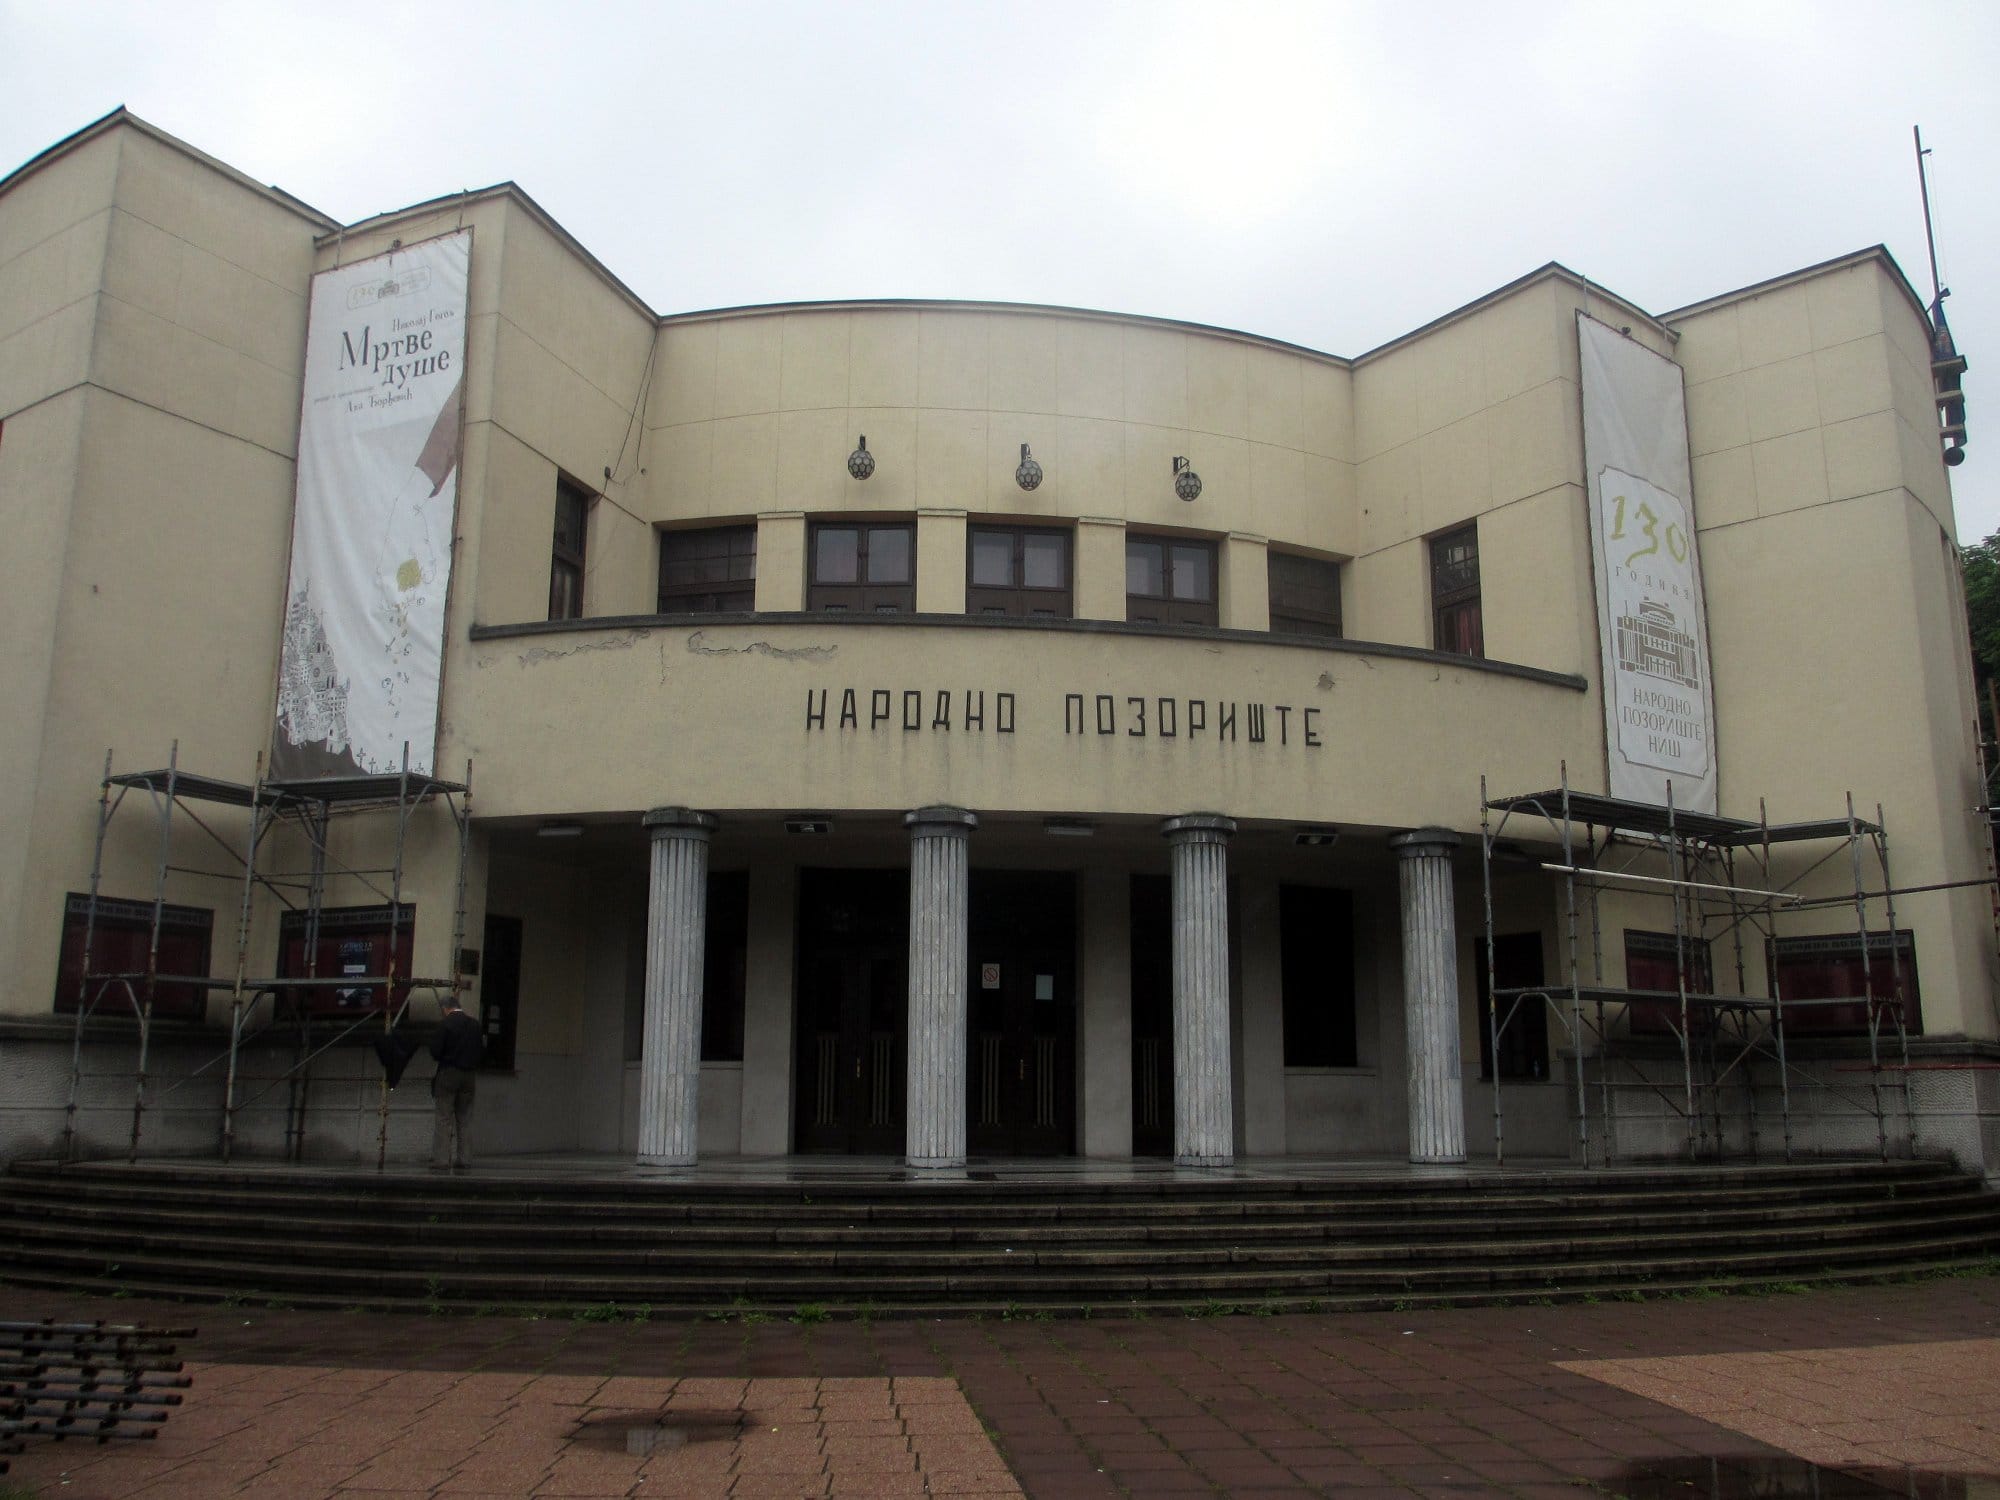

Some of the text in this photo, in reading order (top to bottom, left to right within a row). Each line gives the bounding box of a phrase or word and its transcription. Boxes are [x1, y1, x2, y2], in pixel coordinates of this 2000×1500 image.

[339, 325, 432, 372] Мртве
[382, 350, 450, 389] душе
[1610, 496, 1687, 568] 130
[806, 688, 1322, 747] НАРОДНО ПОЗОРИШТЕ
[1633, 687, 1692, 716] НАРОДНО
[1623, 705, 1702, 741] ПОЗОРИШТЕ
[1648, 734, 1681, 758] НИШ
